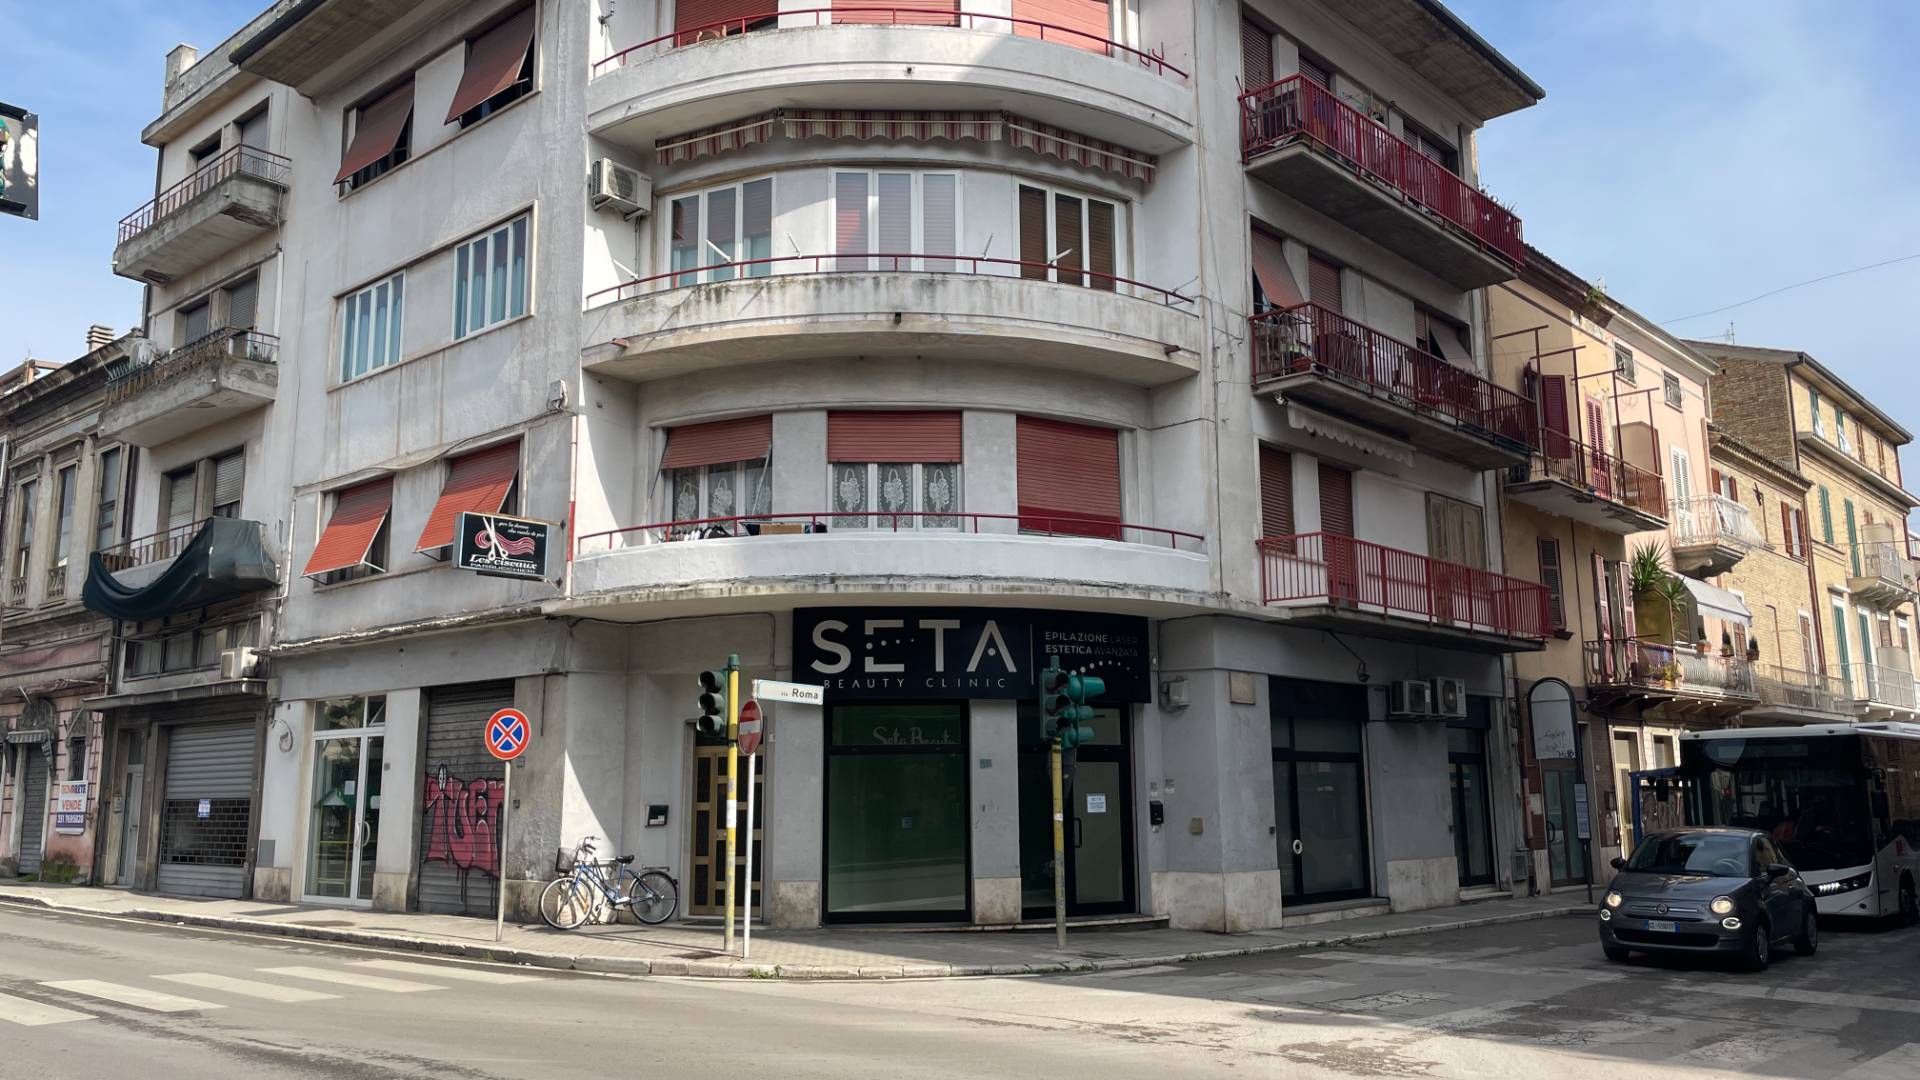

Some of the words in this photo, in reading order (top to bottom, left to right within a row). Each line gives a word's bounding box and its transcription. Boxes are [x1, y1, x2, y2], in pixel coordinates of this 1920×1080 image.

[469, 554, 490, 564] Les
[493, 557, 538, 570] ciseaux
[1044, 631, 1108, 643] EPILAZIONE
[810, 619, 1018, 674] SETA
[1044, 644, 1093, 656] ESTETICA
[823, 678, 905, 689] BEAUTY
[925, 678, 1006, 688] CLINIC
[791, 688, 819, 700] Roma
[62, 799, 82, 811] VENDE
